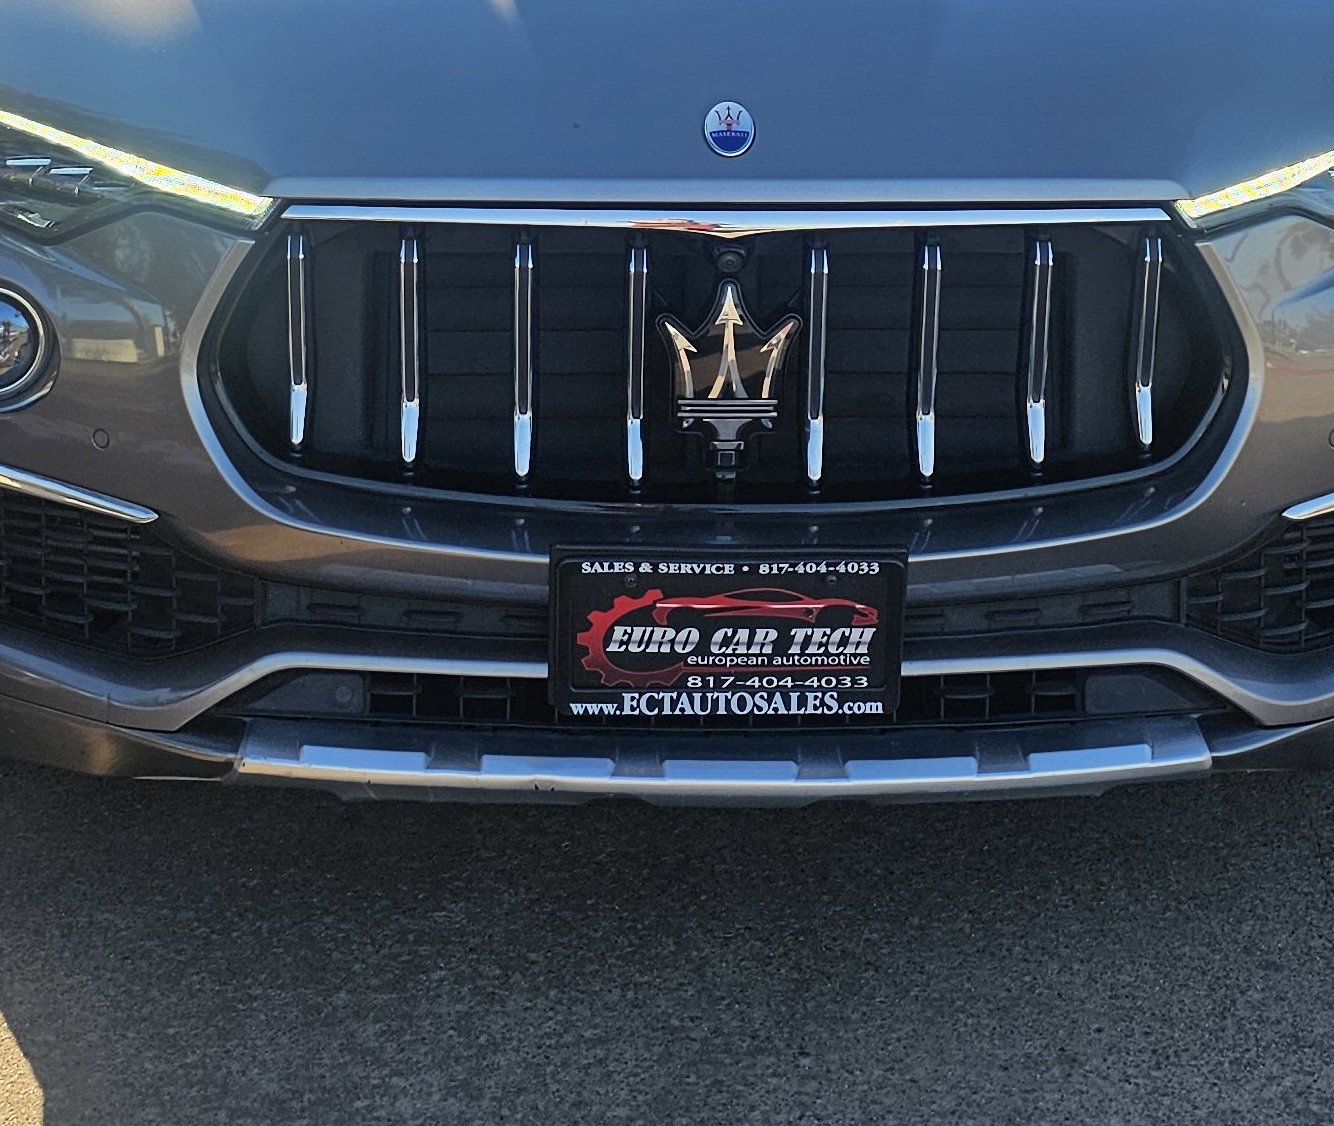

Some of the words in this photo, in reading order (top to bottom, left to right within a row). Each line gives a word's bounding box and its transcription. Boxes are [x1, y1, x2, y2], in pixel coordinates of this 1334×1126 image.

[581, 561, 635, 574] SALES
[639, 561, 653, 574] &
[657, 562, 735, 575] SERVICE
[758, 560, 880, 575] 817-404-4033
[605, 626, 700, 654] EURO
[709, 626, 779, 654] CAR
[787, 626, 876, 655] TECH
[687, 655, 768, 667] european
[773, 654, 871, 666] automotive
[687, 675, 868, 689] 817-404-4033
[569, 691, 884, 716] www.ECTAUTOSALES.com
